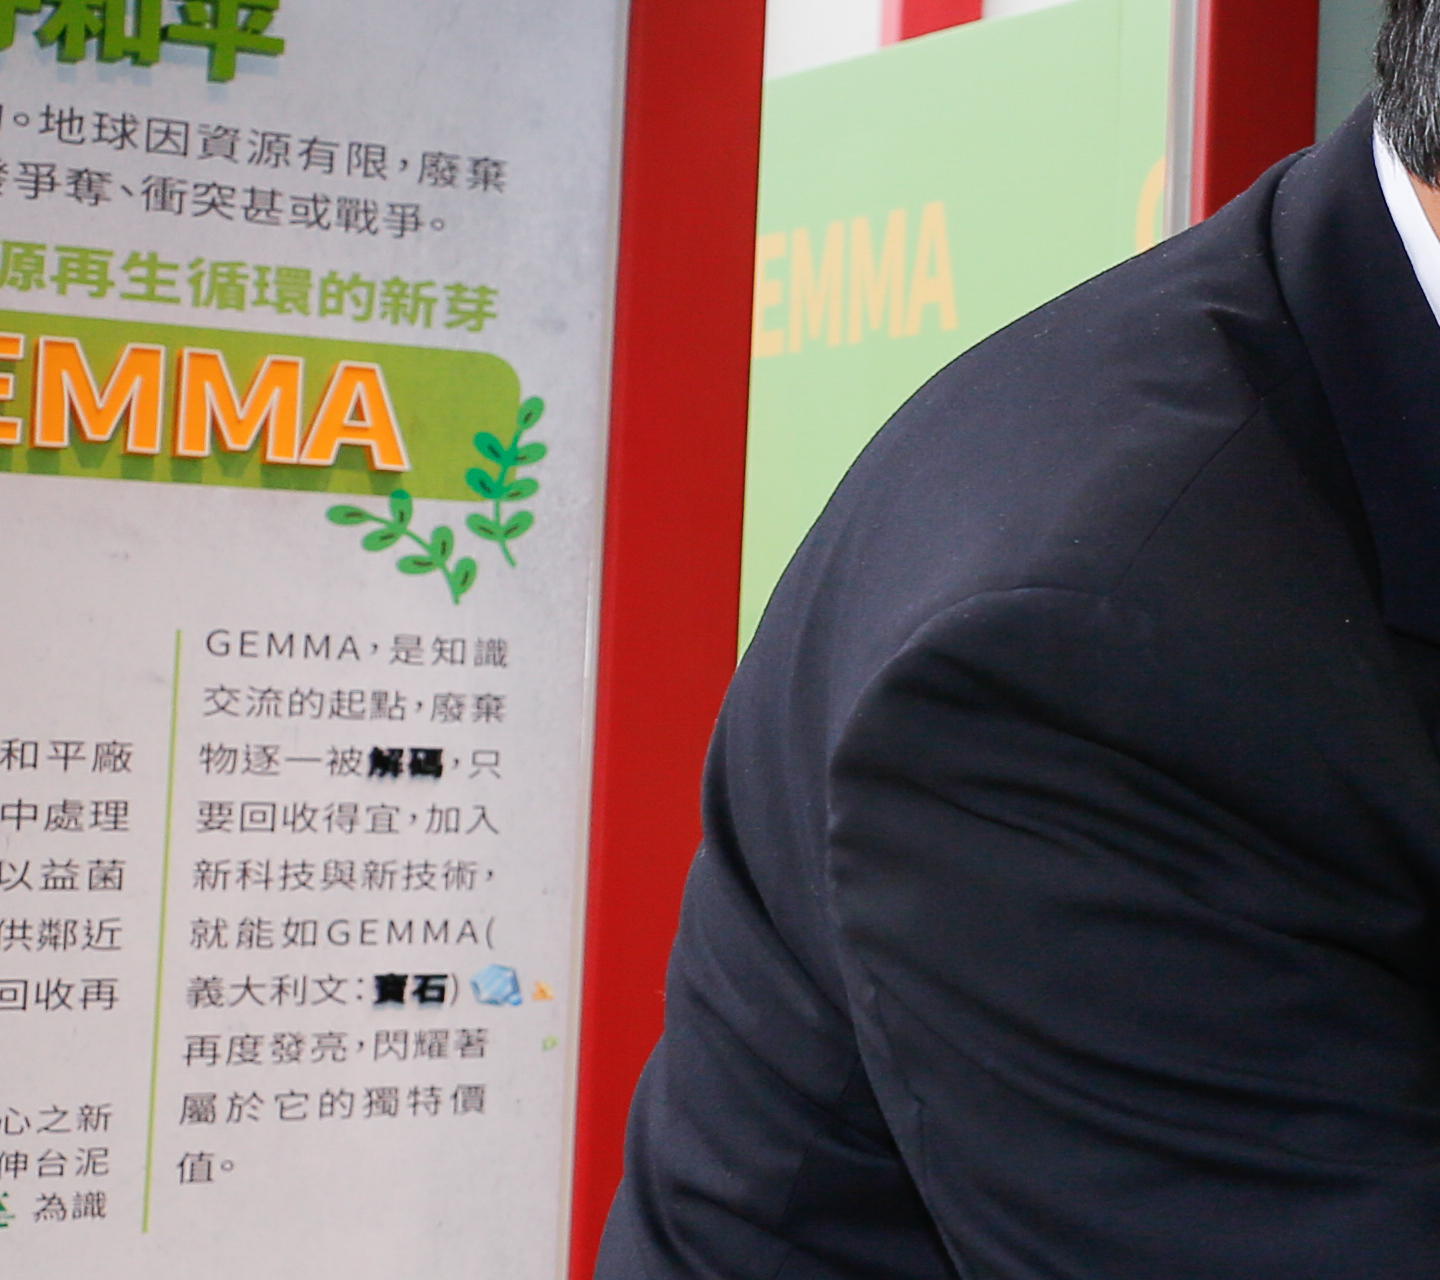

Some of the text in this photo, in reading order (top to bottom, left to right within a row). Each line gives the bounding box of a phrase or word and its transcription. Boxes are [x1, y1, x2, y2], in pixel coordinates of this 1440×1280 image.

[0, 103, 508, 194] 。地球因資源有限，廢棄
[0, 160, 446, 239] 爭奪、衝突甚或戰爭。
[203, 685, 507, 723] 交流的起點，廢棄
[0, 739, 134, 774] 和平廠
[0, 798, 130, 834] 中處理
[196, 800, 499, 836] 要回收得宜，加入
[183, 1028, 488, 1068] 再度發亮，閃耀著
[179, 1083, 487, 1125] 屬於它的獨特價
